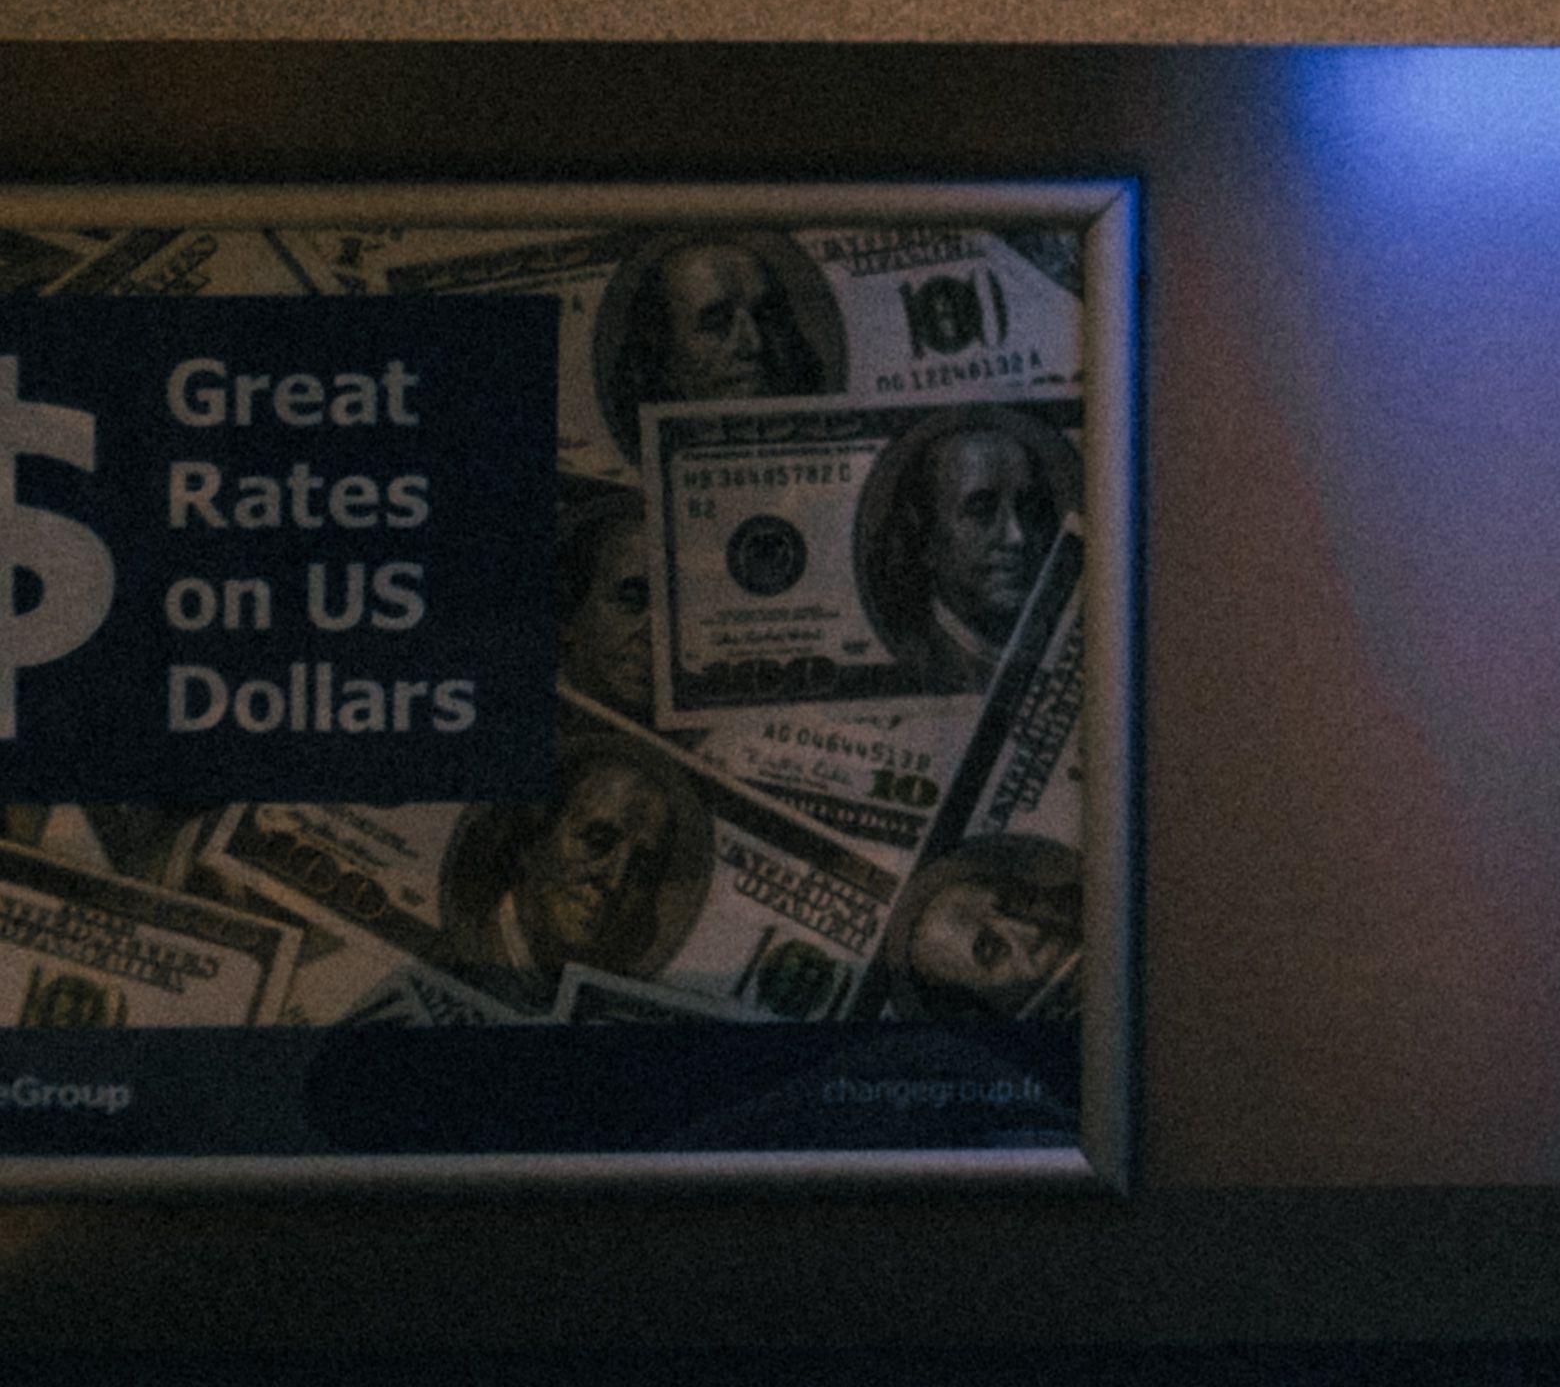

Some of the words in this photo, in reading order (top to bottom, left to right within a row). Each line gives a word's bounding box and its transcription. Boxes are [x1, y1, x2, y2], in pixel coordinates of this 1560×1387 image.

[165, 353, 422, 430] Great
[165, 460, 432, 532] Rates
[165, 575, 271, 633] on
[307, 560, 427, 633] US
[166, 662, 477, 736] Dollars
[870, 769, 940, 809] 10
